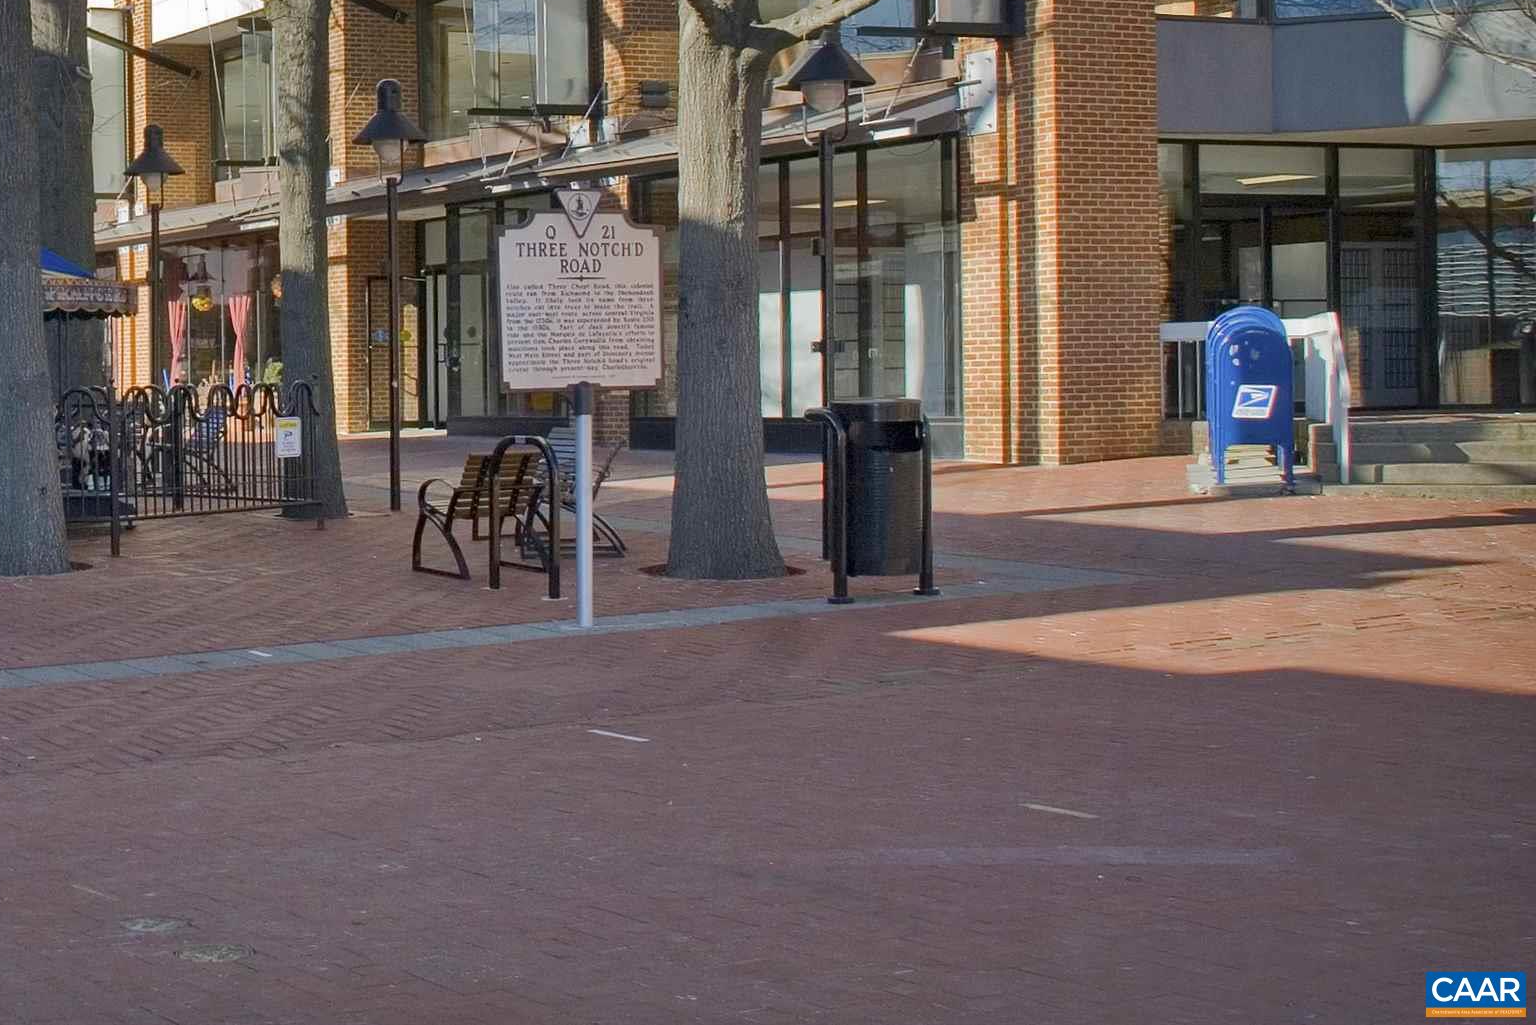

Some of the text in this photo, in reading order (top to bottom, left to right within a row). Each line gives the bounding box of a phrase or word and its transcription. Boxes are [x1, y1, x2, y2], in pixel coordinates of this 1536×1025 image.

[601, 225, 616, 240] 21
[515, 242, 644, 258] THREE NOTCH'D
[560, 258, 602, 273] ROAD
